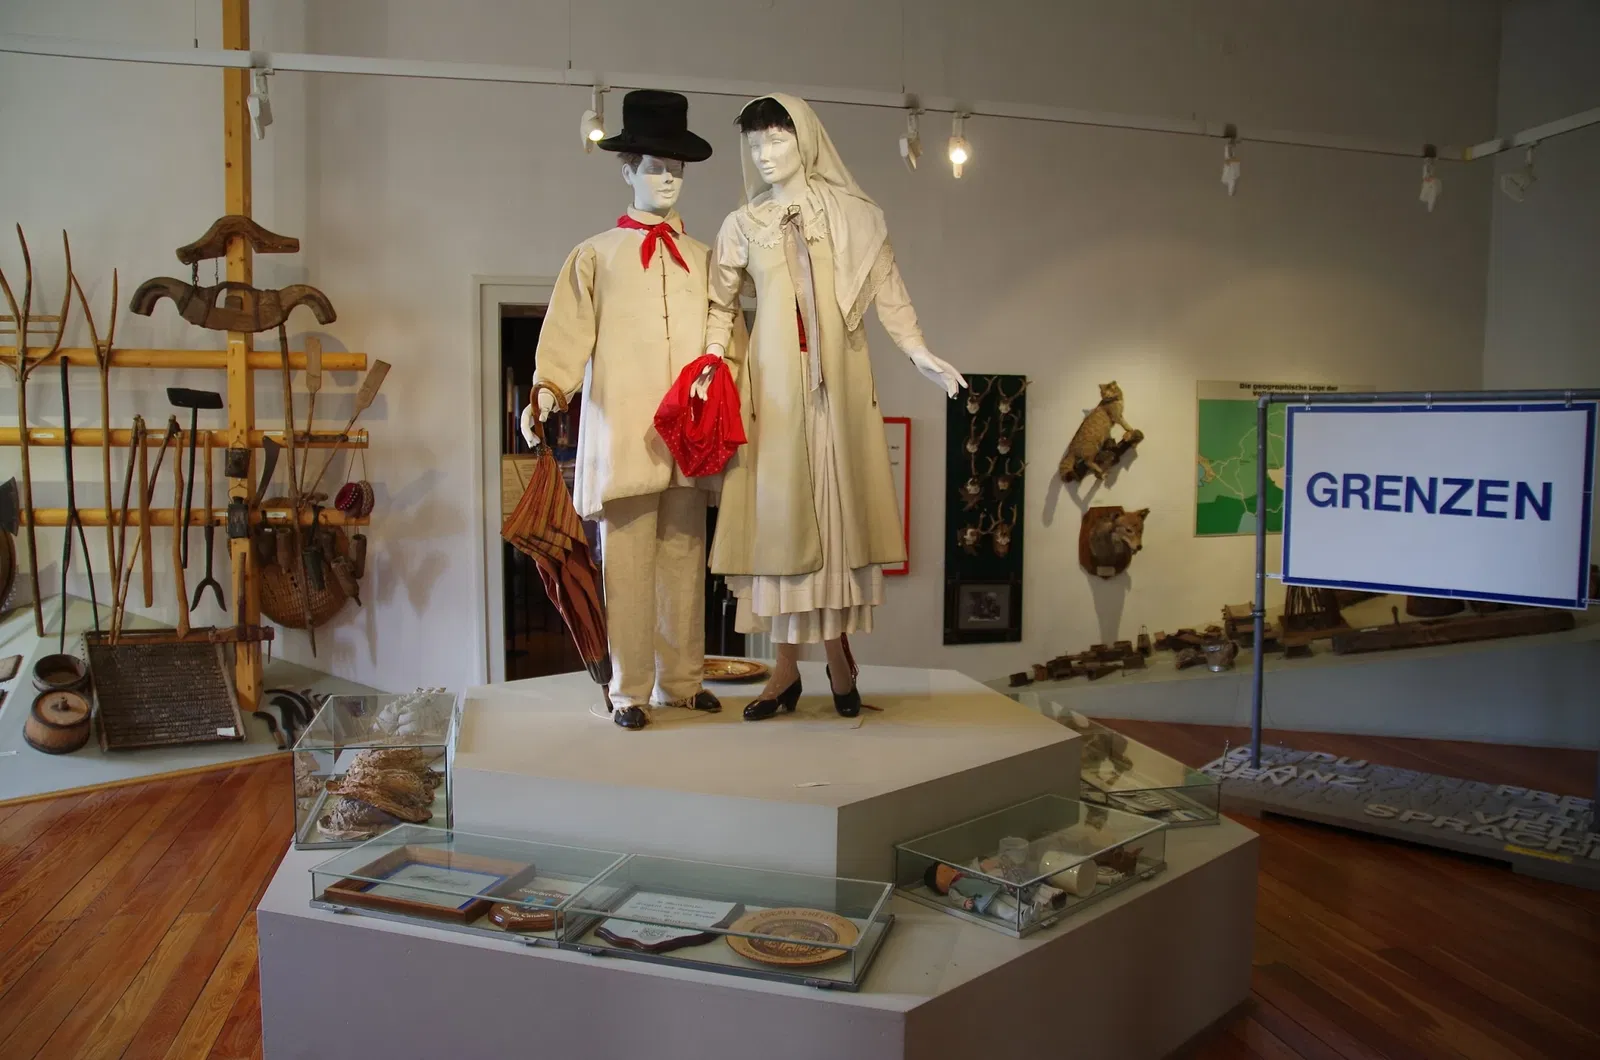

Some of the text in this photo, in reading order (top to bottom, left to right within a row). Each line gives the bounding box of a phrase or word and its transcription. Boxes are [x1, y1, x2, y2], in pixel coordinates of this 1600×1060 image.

[1252, 383, 1307, 391] geographische
[1308, 384, 1325, 392] Lage
[1306, 471, 1552, 521] GRENZEN
[759, 910, 797, 920] CORPUS
